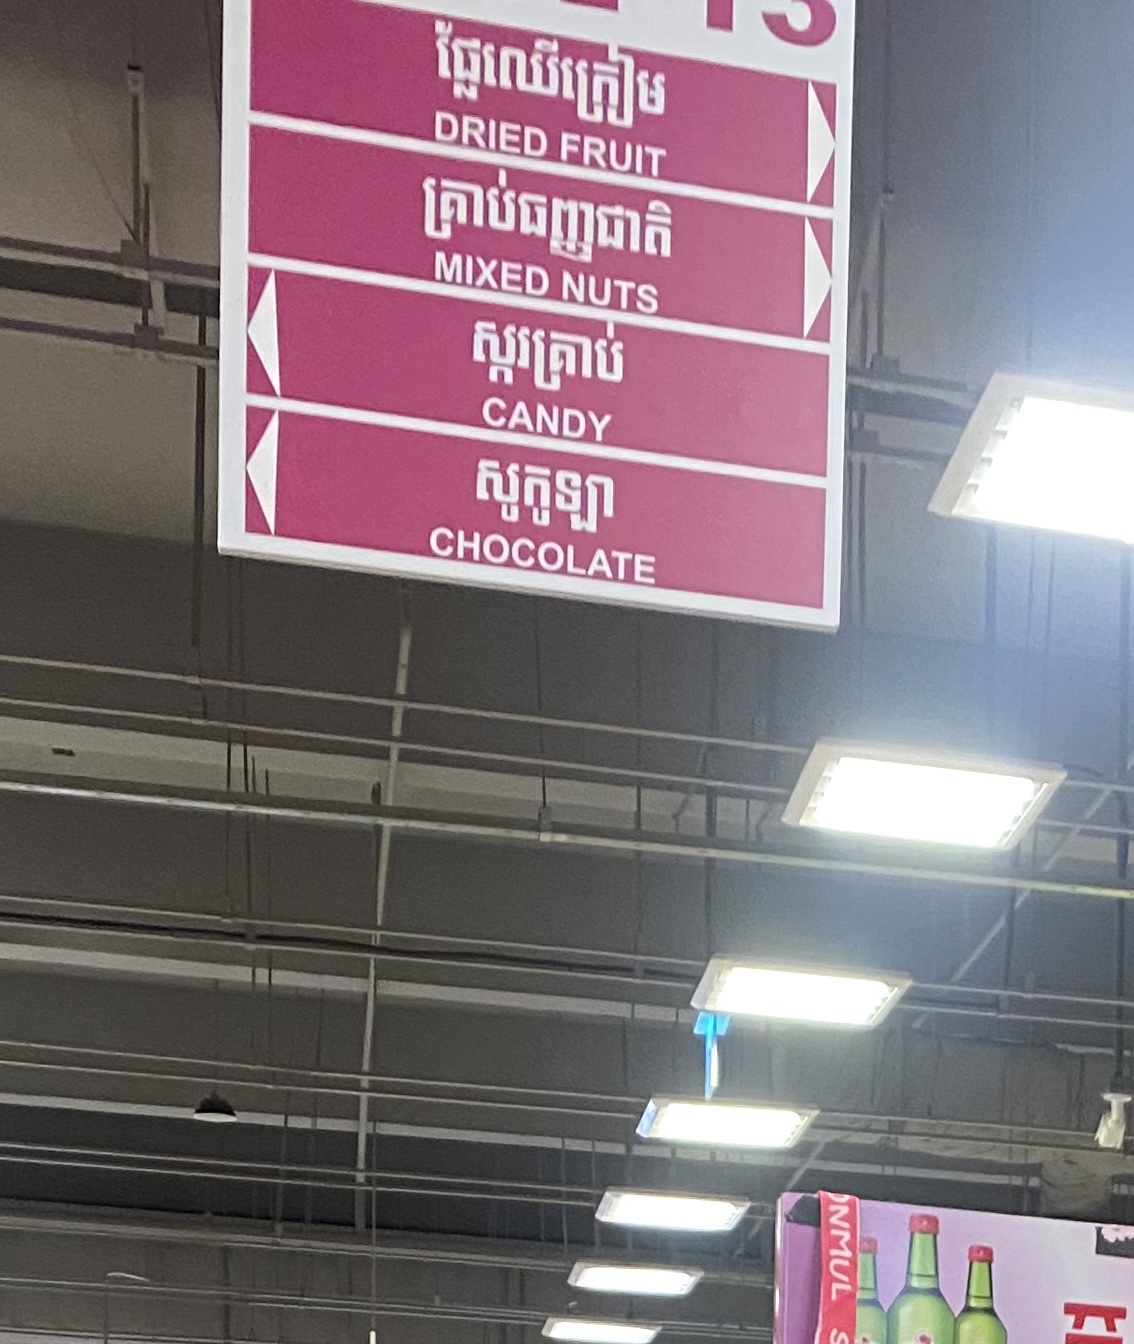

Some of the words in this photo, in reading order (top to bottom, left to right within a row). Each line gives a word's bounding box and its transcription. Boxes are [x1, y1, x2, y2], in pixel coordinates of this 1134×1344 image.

[434, 112, 548, 158] DRIED
[560, 133, 667, 176] FRUIT
[434, 251, 549, 294] MIXED
[562, 272, 658, 313] NUTS
[482, 398, 611, 442] CANDY
[430, 527, 655, 582] CHOCOLATE
